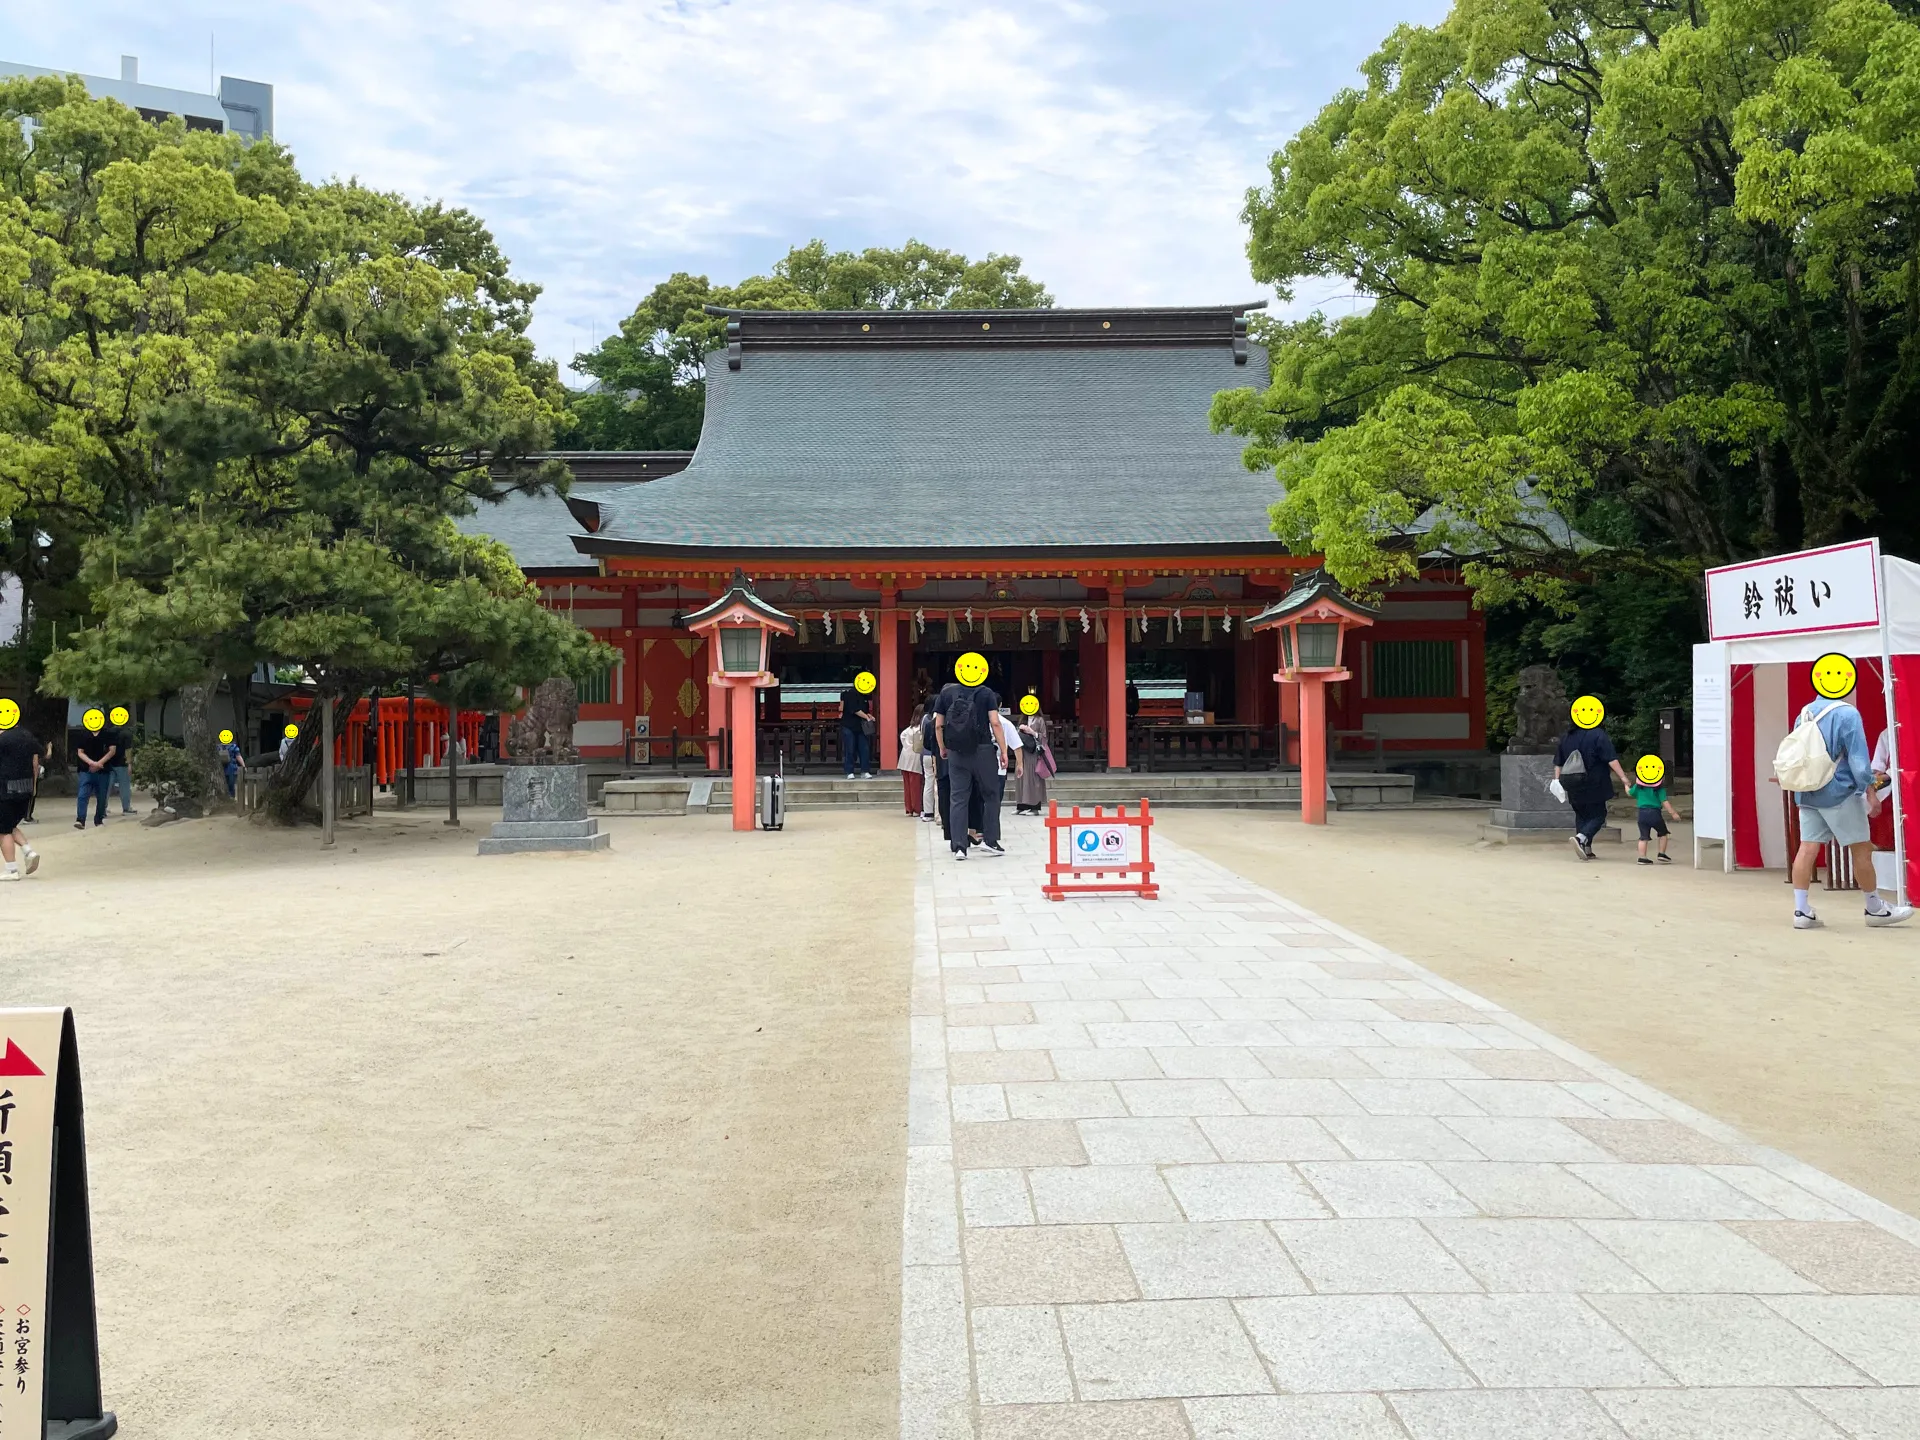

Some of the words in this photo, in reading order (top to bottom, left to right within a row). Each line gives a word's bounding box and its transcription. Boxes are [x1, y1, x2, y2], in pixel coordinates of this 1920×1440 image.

[1743, 575, 1831, 620] 鈴祓い
[13, 1318, 31, 1394] お宮参り
